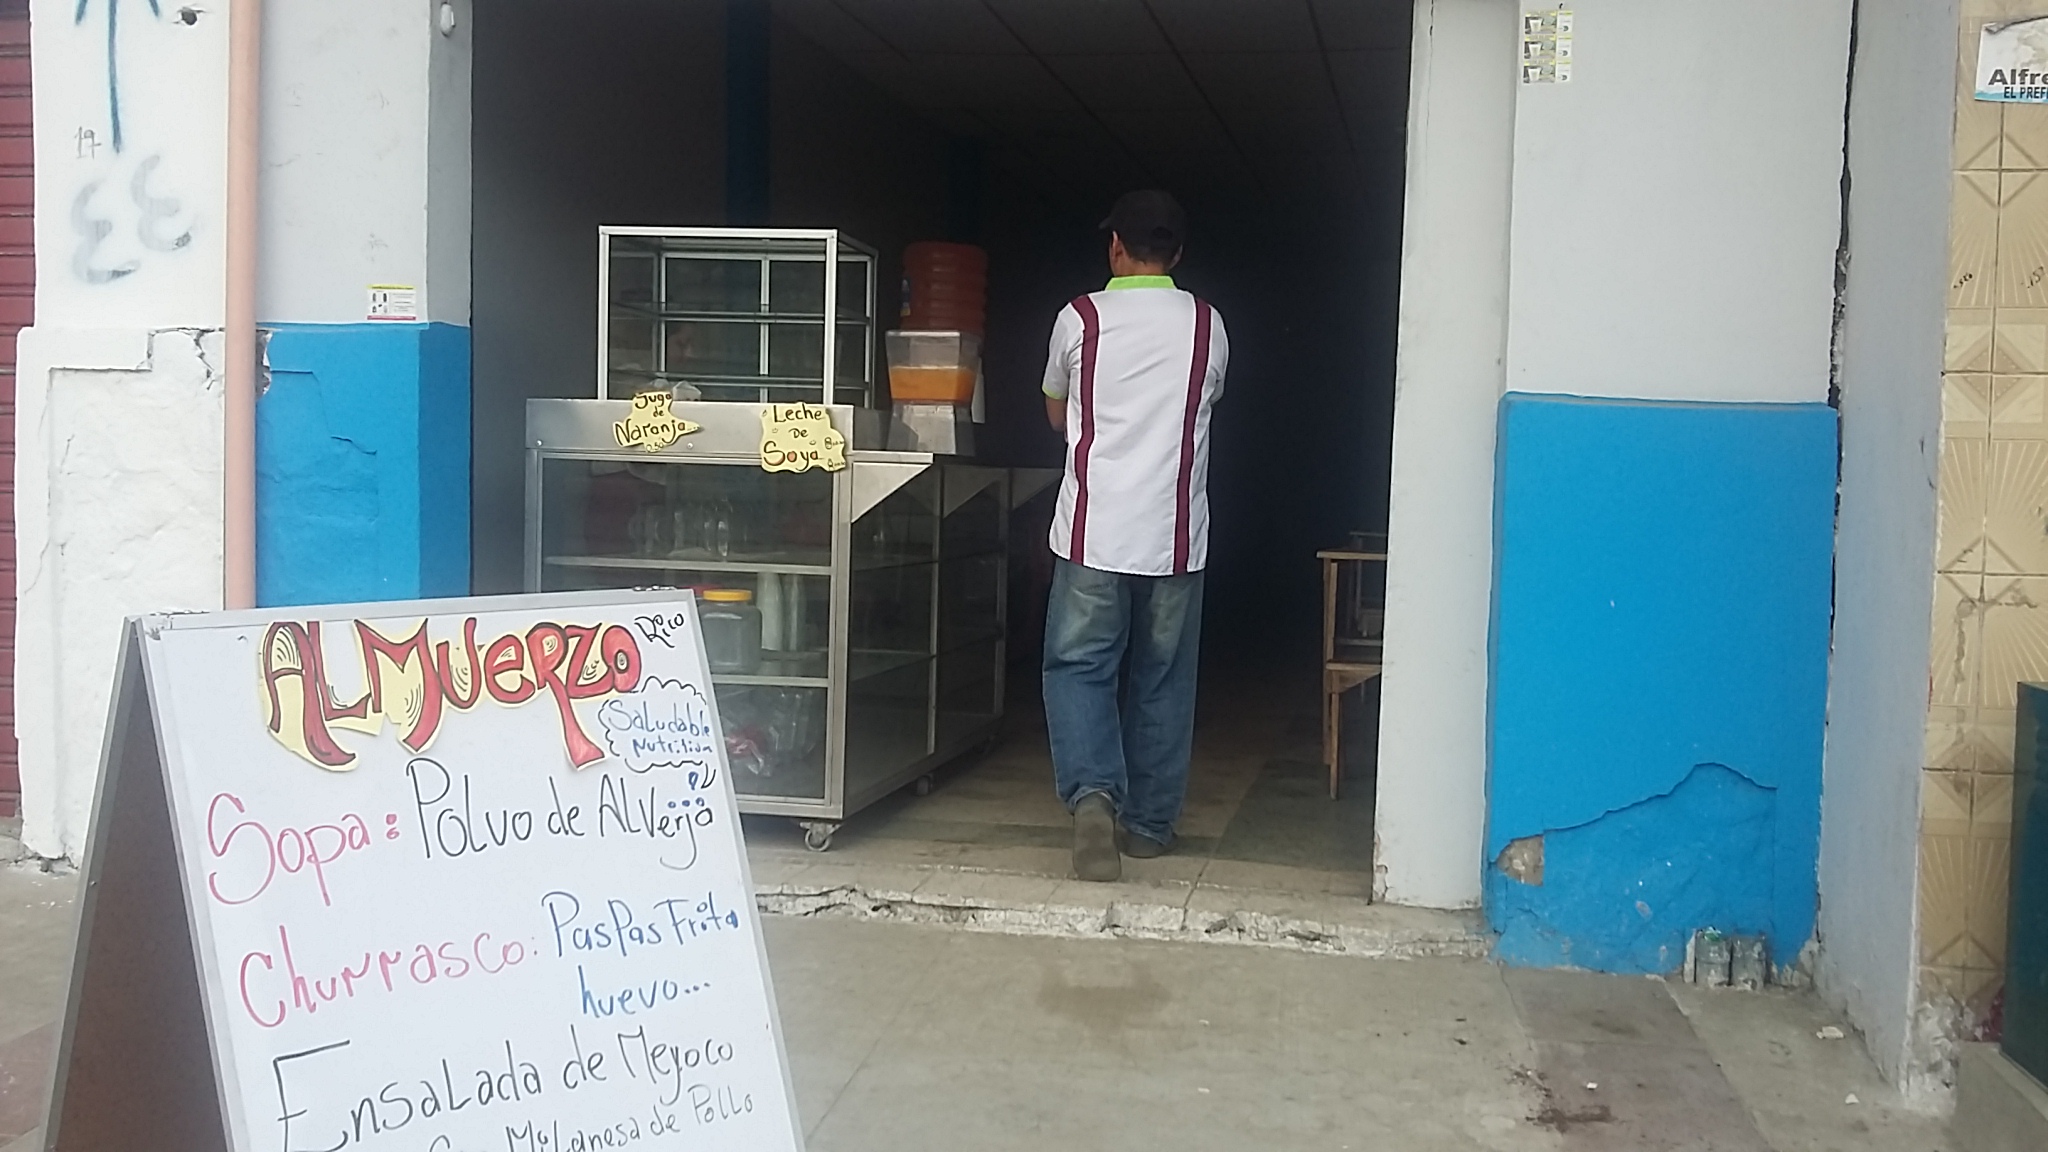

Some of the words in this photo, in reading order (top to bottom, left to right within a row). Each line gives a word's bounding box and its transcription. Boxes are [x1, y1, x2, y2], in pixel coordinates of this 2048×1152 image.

[2004, 87, 2016, 98] EL
[2020, 87, 2048, 99] PREF
[653, 406, 664, 417] de
[773, 402, 822, 422] Leche
[763, 441, 818, 471] Soya
[547, 776, 585, 837] de
[563, 1024, 607, 1089] de
[651, 1104, 680, 1136] de
